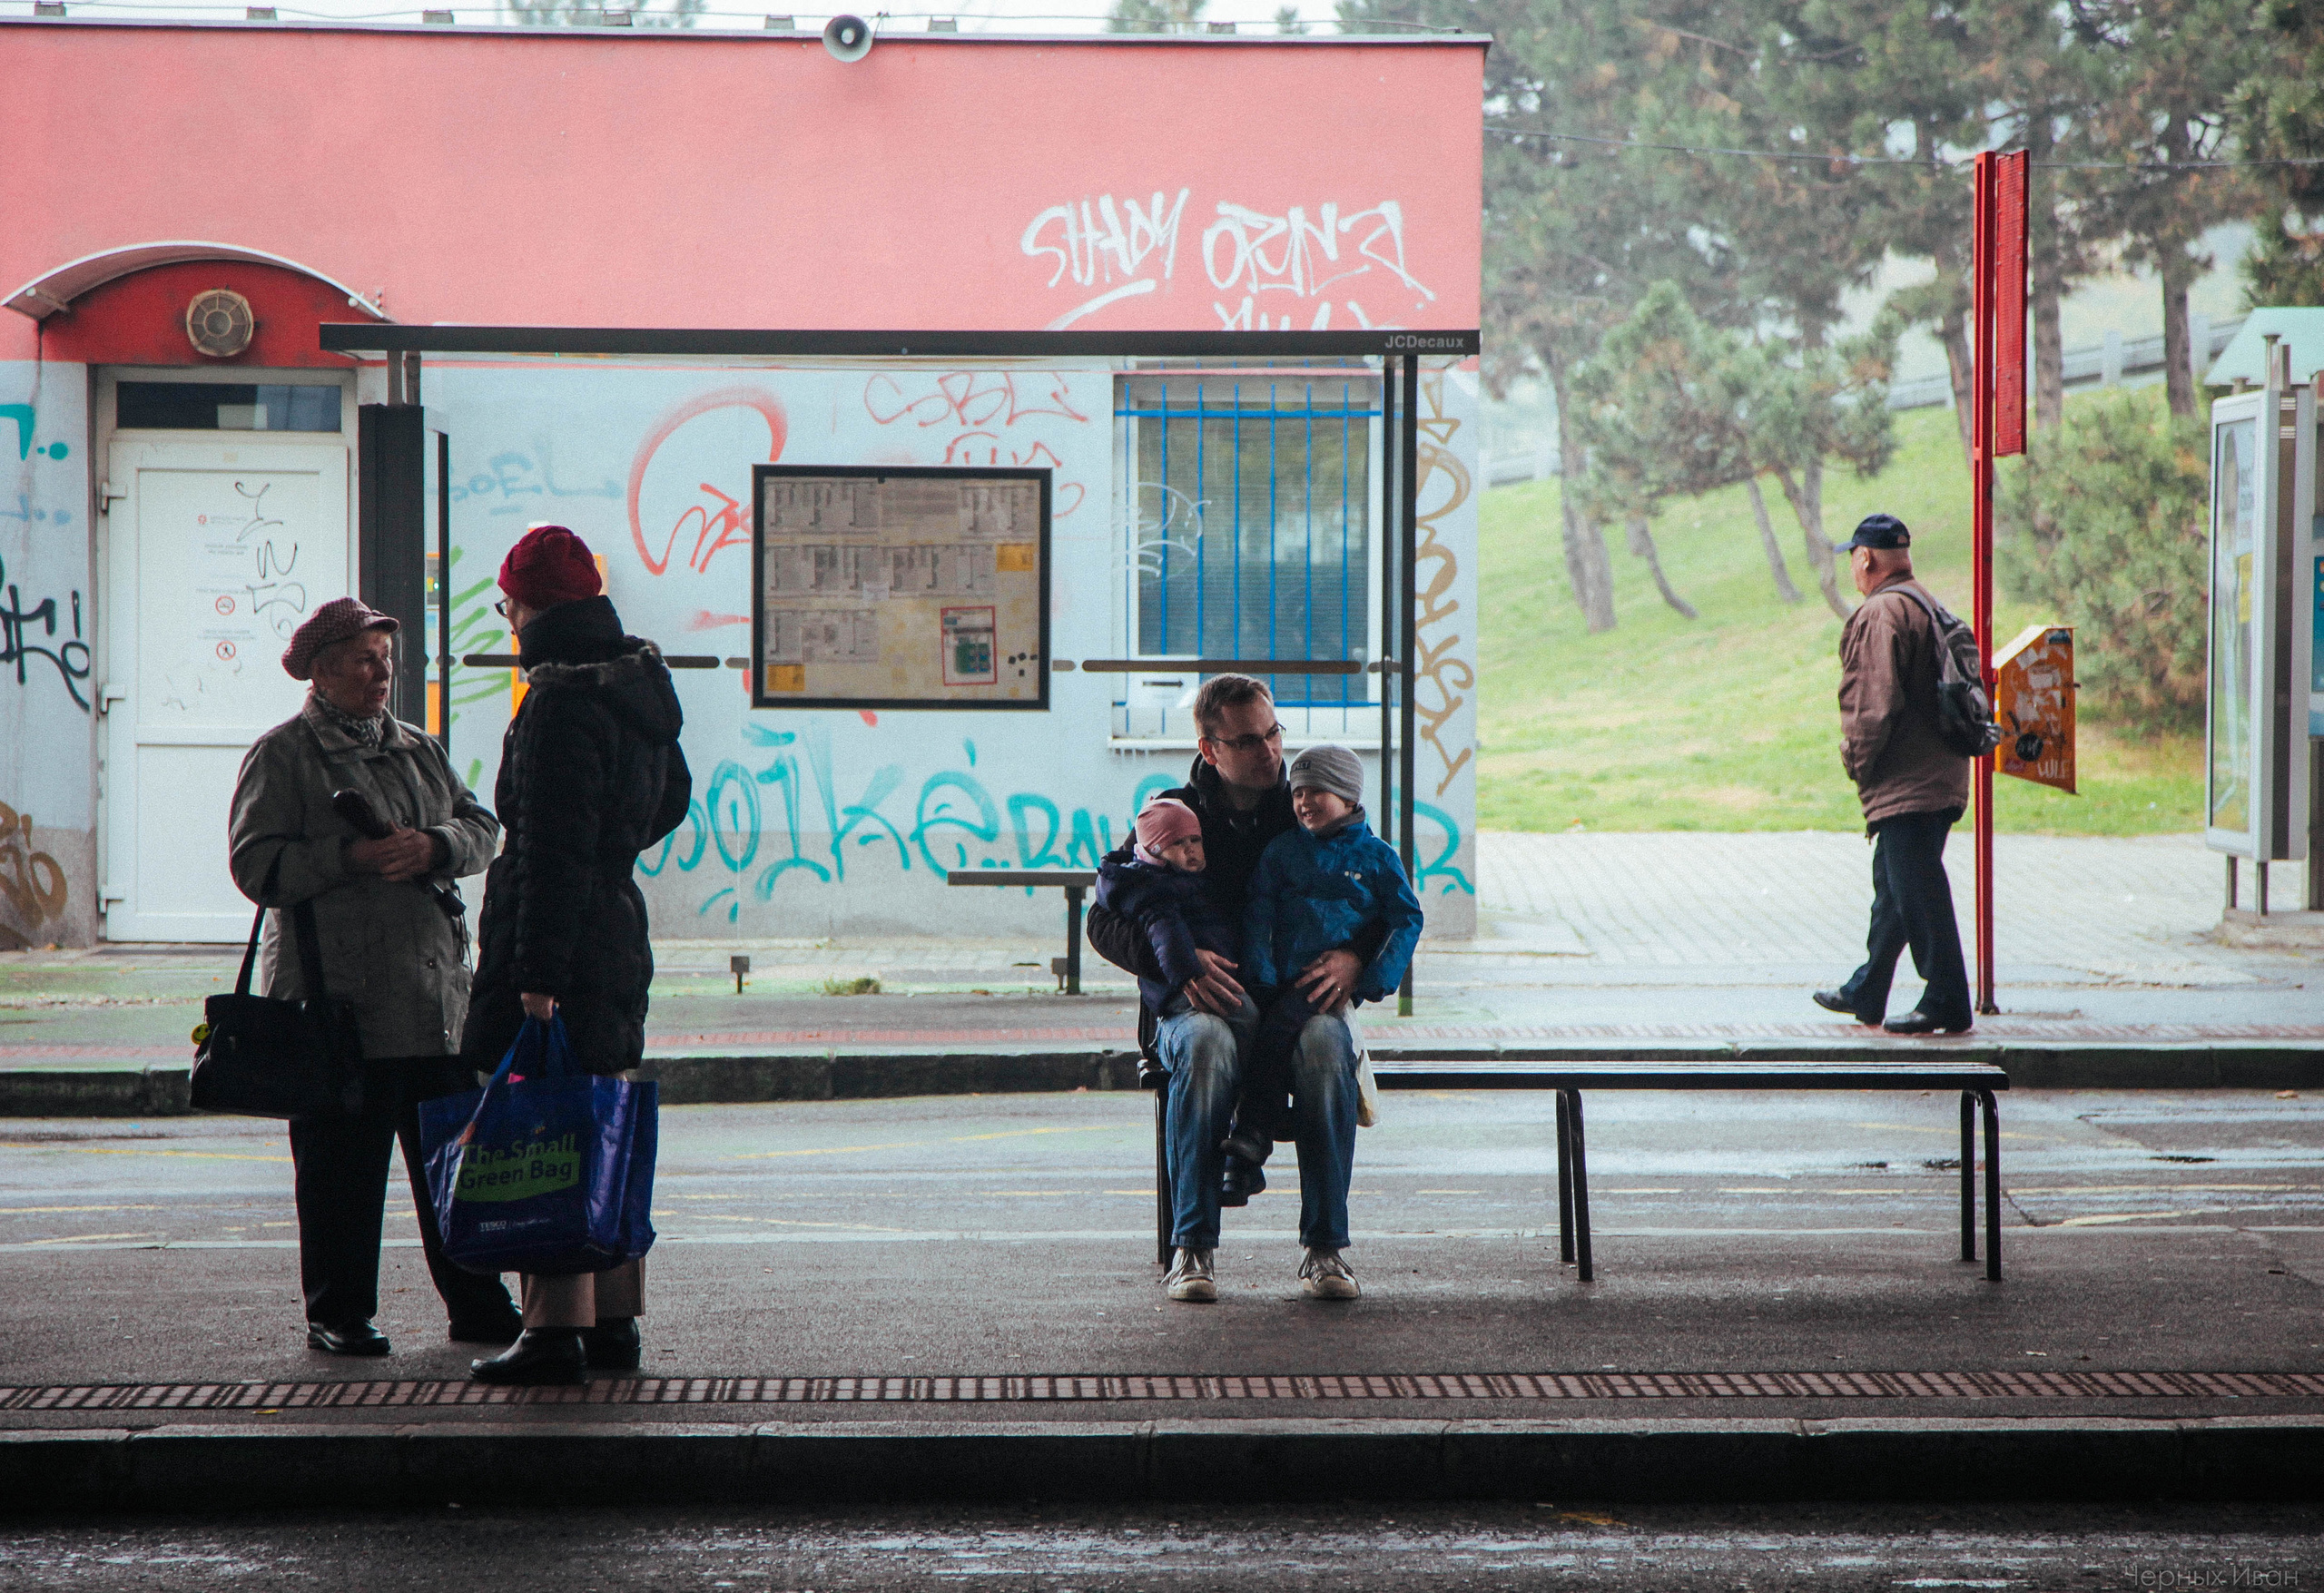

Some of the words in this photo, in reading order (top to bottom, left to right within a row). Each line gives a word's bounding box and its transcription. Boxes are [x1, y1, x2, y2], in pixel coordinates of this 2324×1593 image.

[1384, 334, 1464, 349] JCDecaux
[464, 1145, 505, 1165] The
[511, 1134, 576, 1159] Small
[458, 1165, 524, 1190] Green
[530, 1159, 573, 1181] Bag
